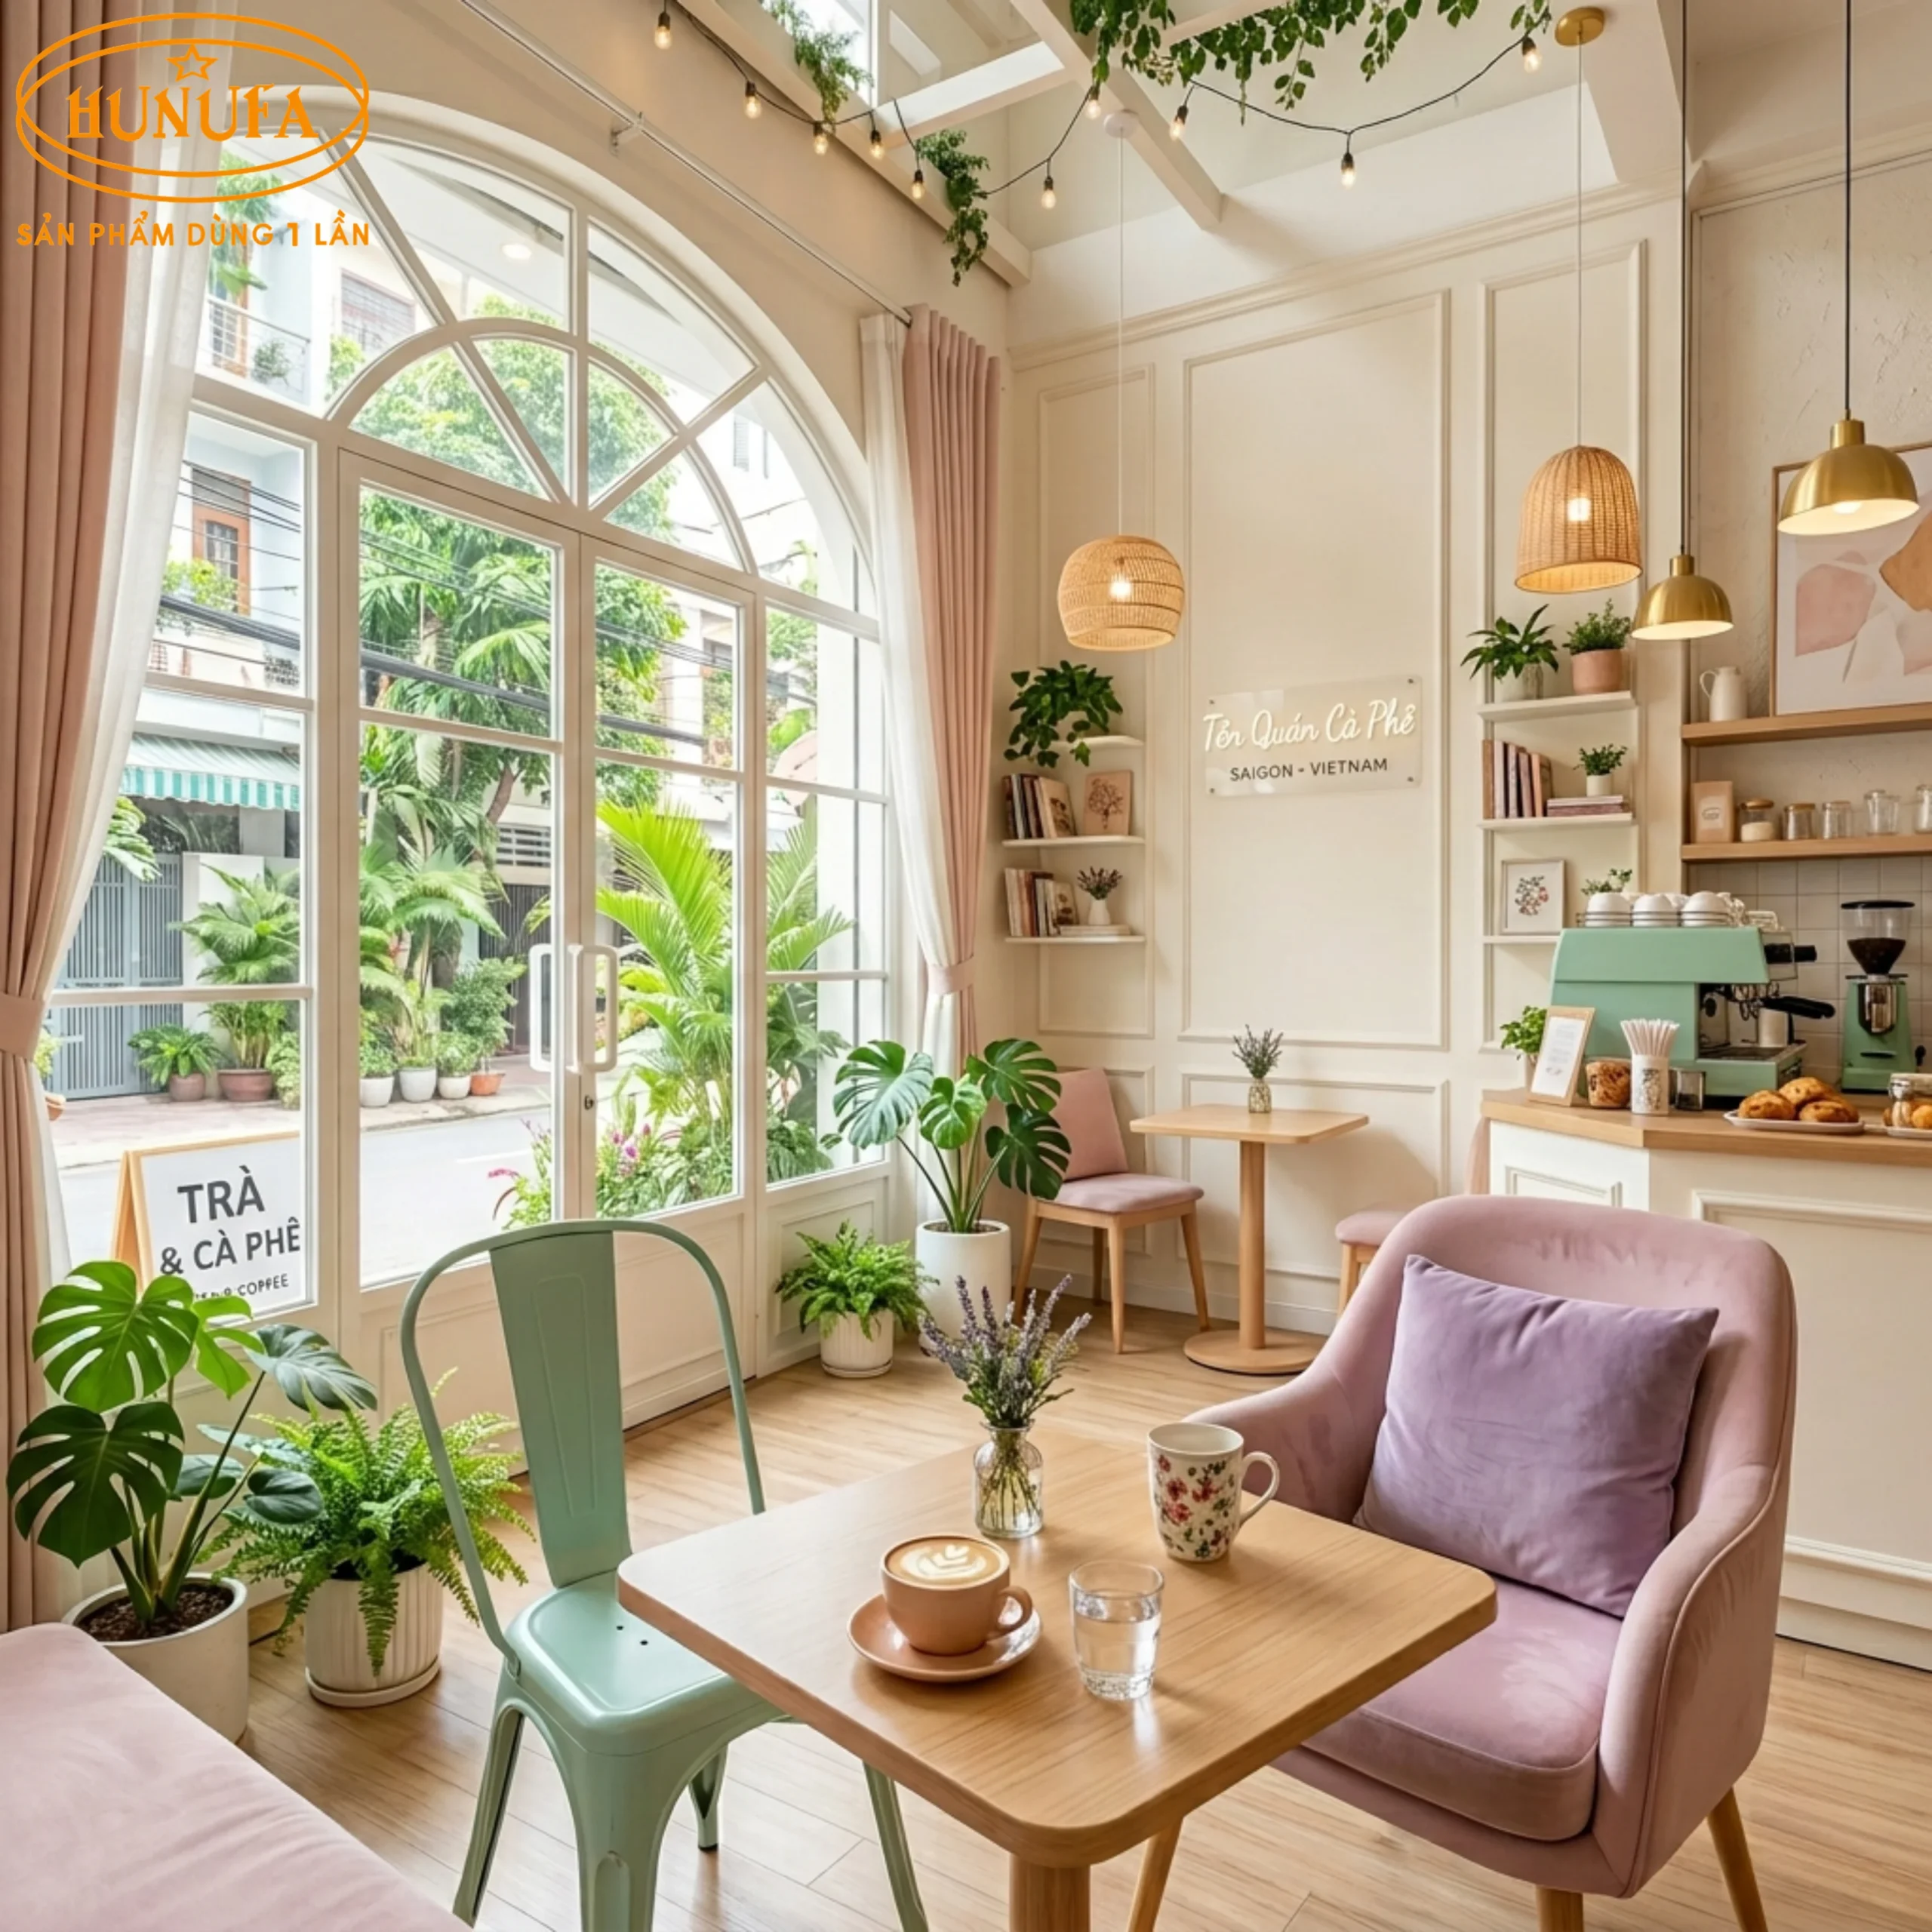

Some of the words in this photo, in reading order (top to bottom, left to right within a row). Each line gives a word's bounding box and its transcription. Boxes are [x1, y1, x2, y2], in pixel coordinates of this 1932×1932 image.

[1252, 709, 1319, 749] Quán
[1326, 703, 1361, 743] Cà
[1230, 764, 1293, 781] SAIGON
[1309, 758, 1387, 776] VIETNAM
[177, 1164, 265, 1223] TRÀ
[160, 1247, 183, 1275] &
[193, 1229, 237, 1270] CÀ
[245, 1217, 300, 1261] PHÊ
